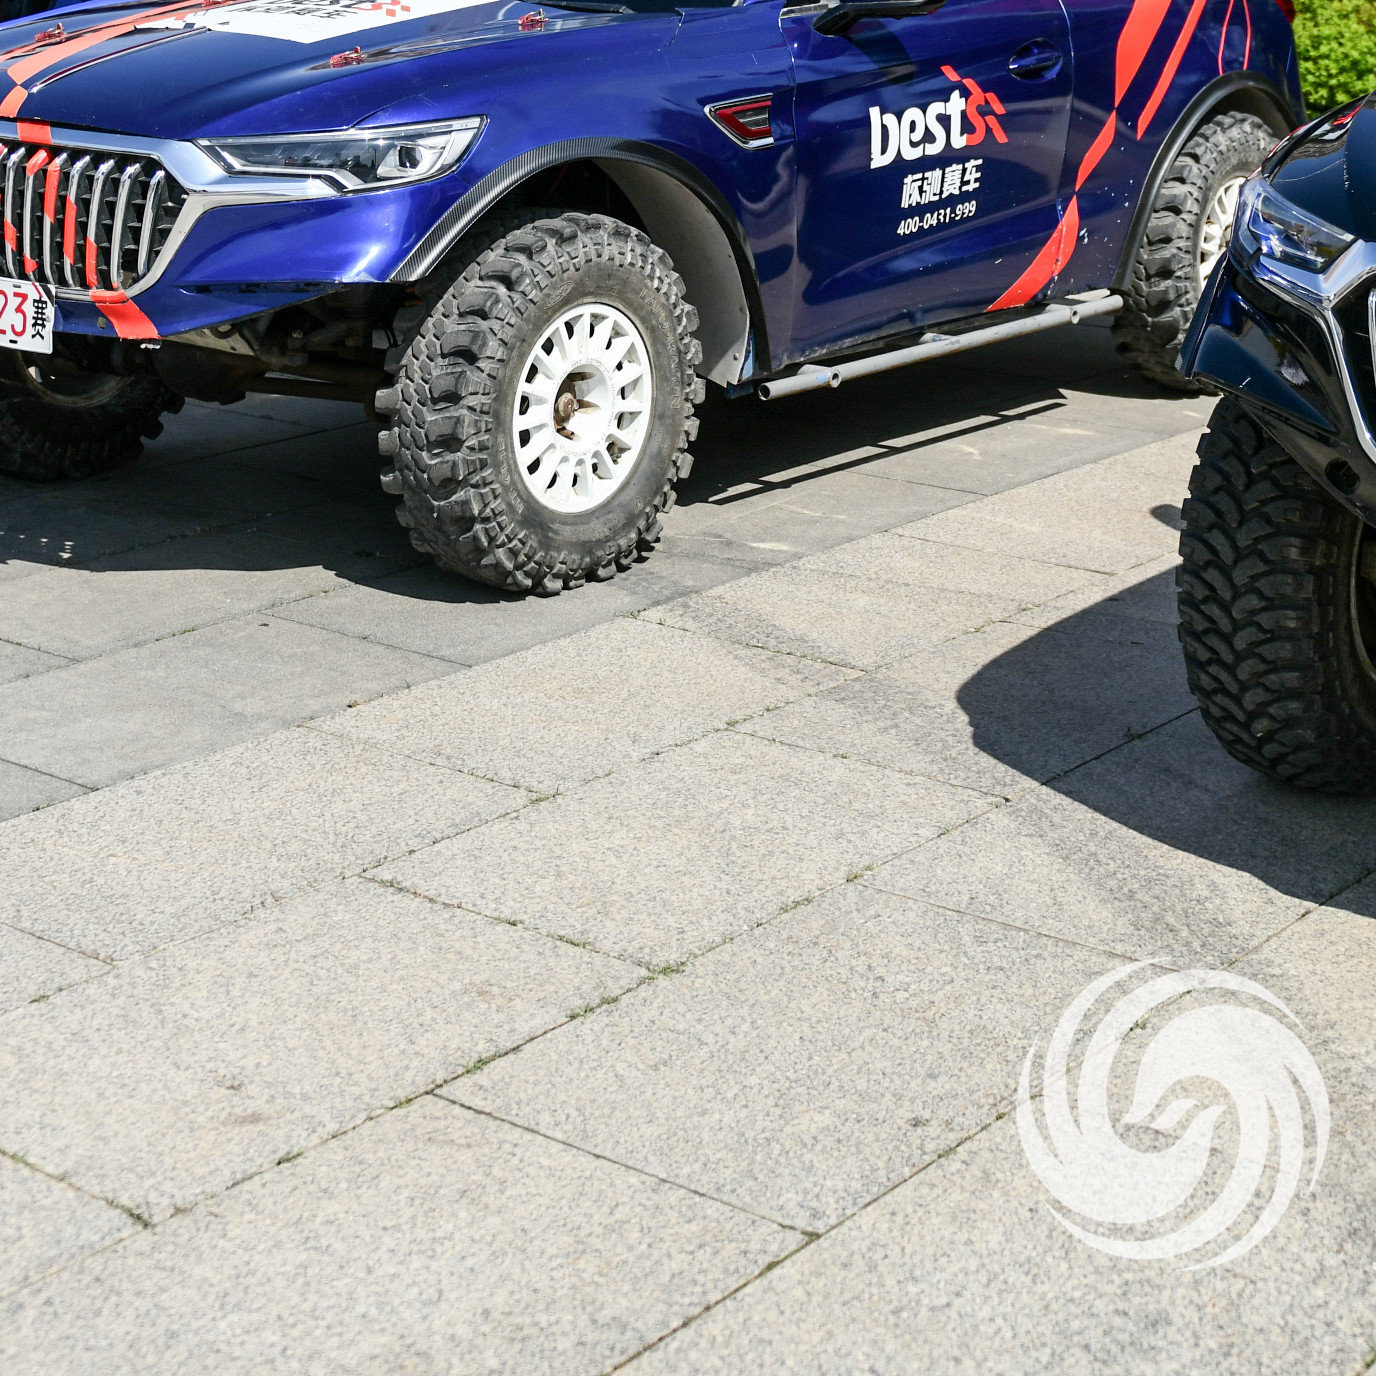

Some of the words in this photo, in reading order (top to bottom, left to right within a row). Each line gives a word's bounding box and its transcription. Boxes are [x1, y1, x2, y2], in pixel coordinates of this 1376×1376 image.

[900, 158, 983, 209] 标驰赛车
[896, 200, 977, 236] 400-0431-999
[31, 296, 48, 341] 赛
